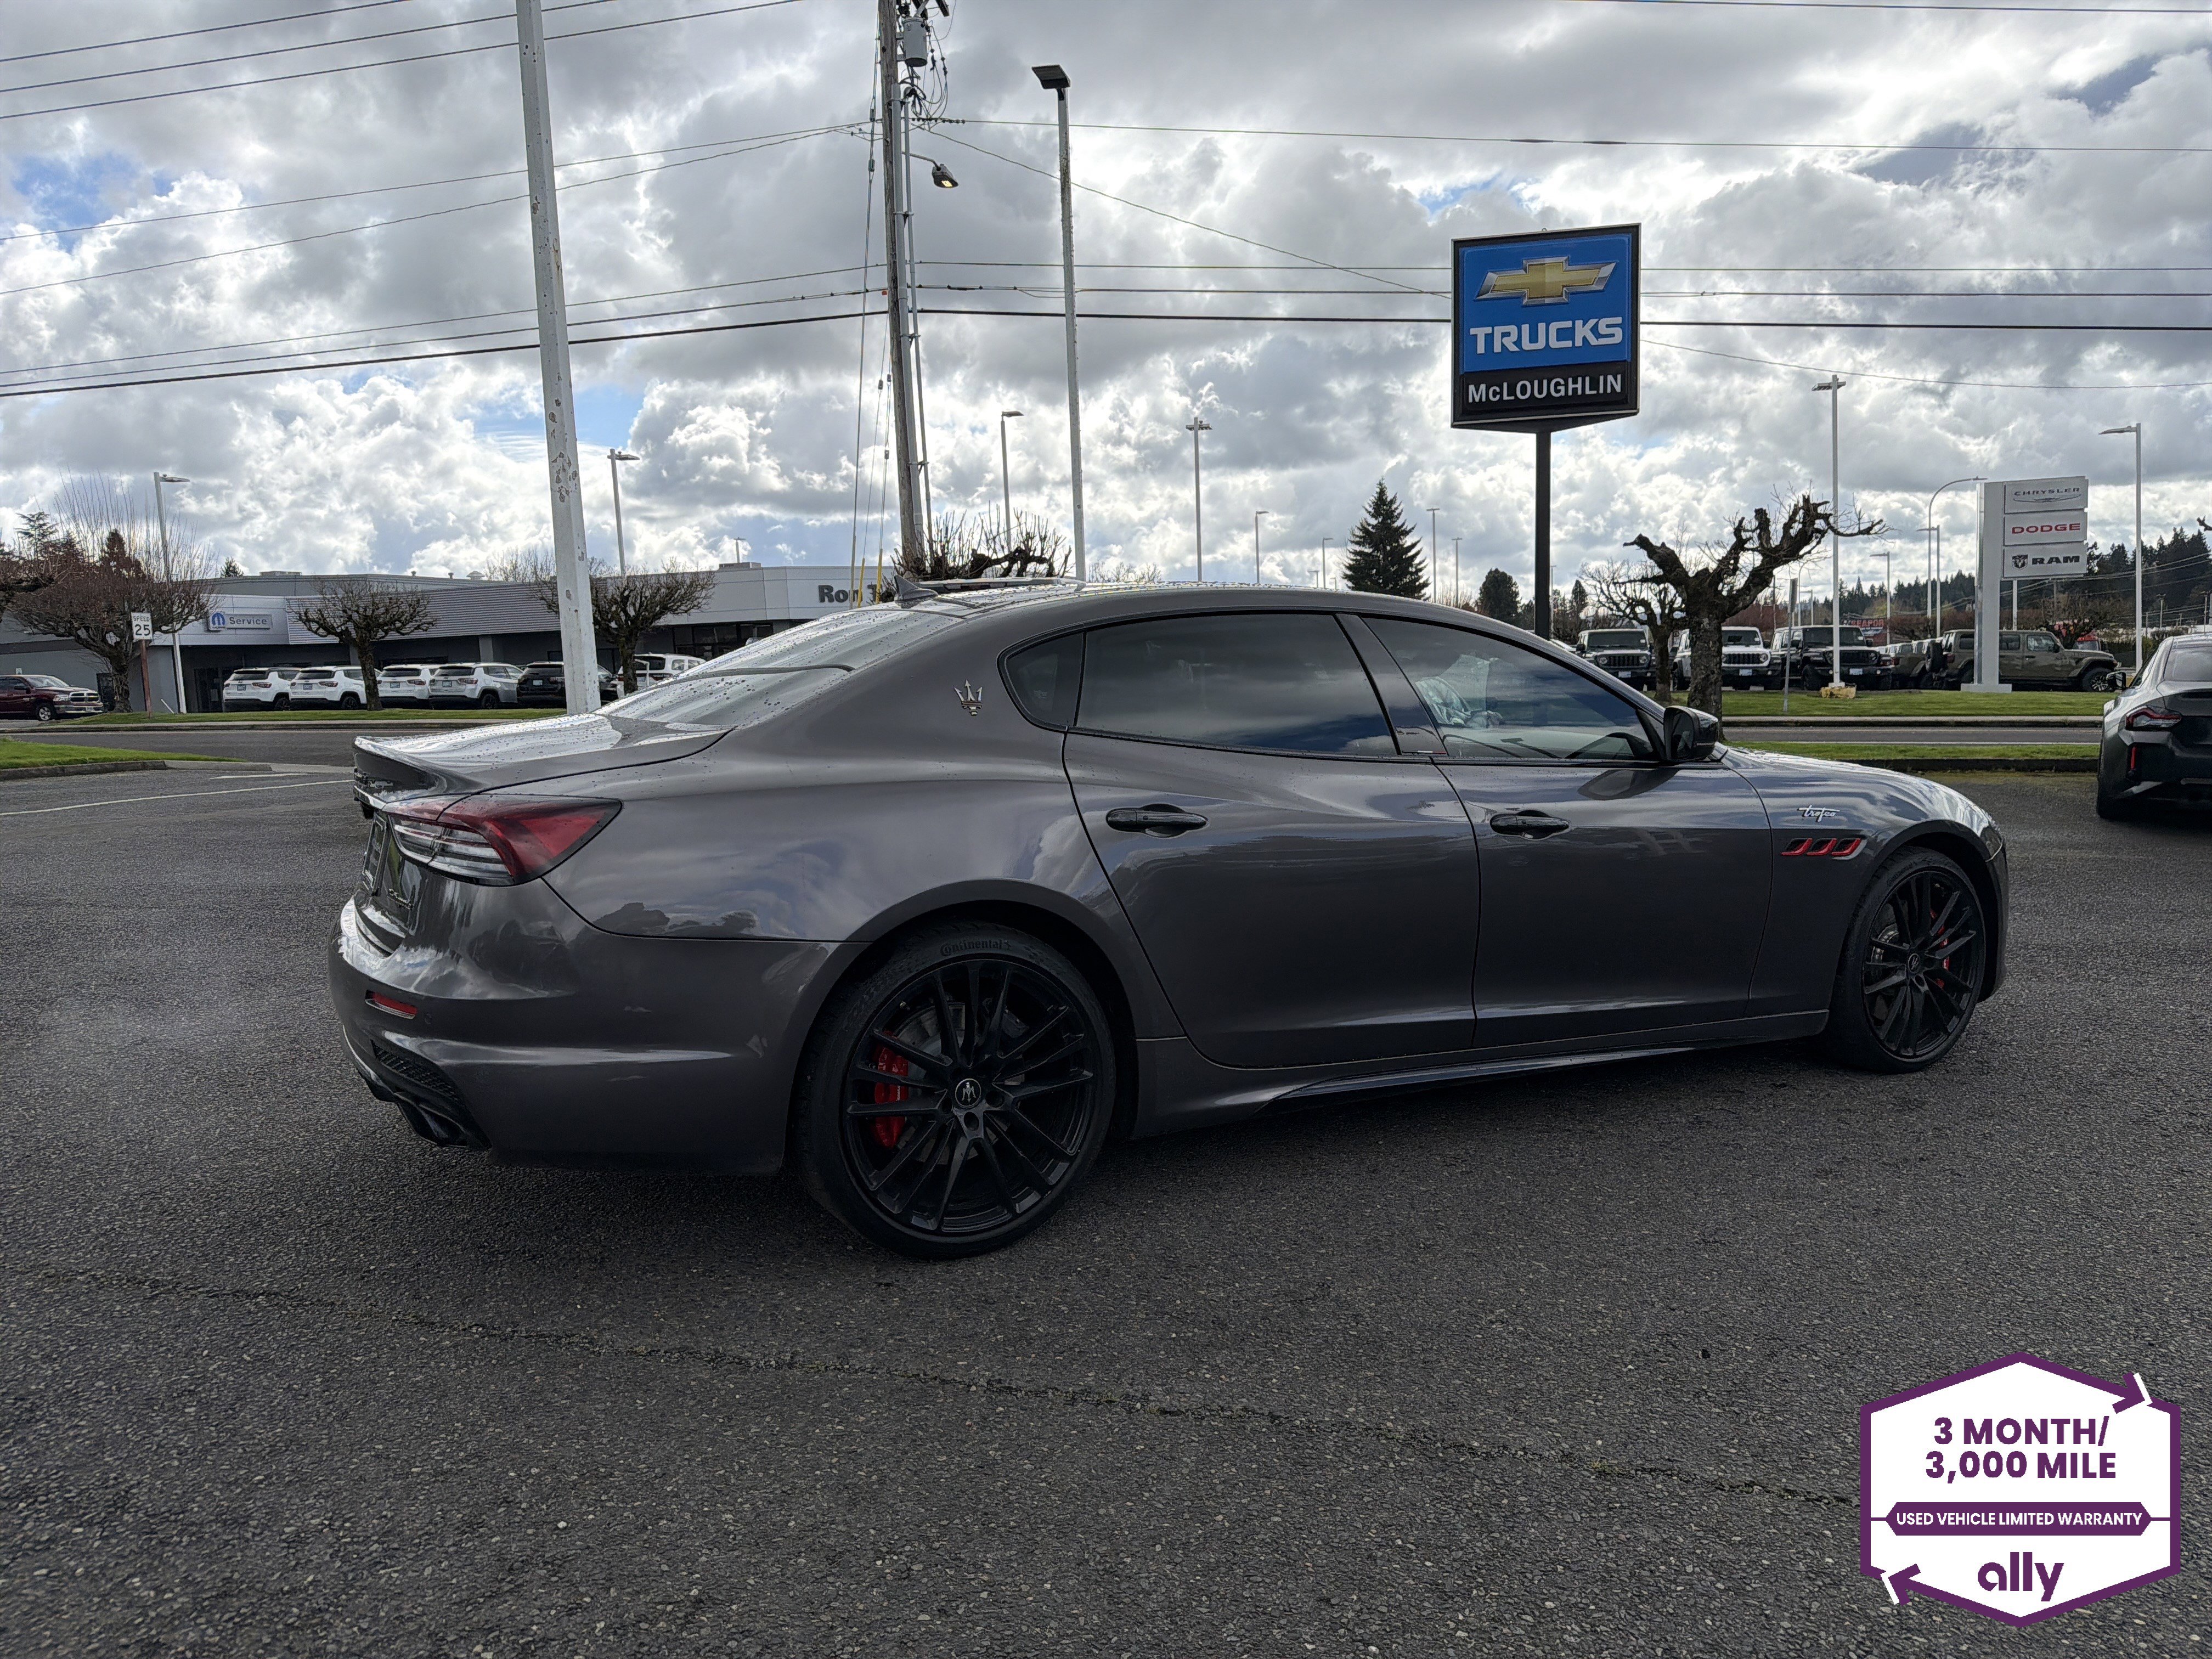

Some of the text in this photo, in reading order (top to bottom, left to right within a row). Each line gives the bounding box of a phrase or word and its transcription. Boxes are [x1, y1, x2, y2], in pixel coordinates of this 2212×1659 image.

[1470, 317, 1623, 354] TRUCKS
[1468, 374, 1622, 403] McLOUGHLIN
[2014, 488, 2080, 496] CHRYSLER
[2012, 523, 2080, 534] DODGE
[2032, 555, 2080, 565] RAM
[229, 617, 267, 625] Service
[134, 624, 151, 636] 25
[940, 939, 1002, 956] Continental
